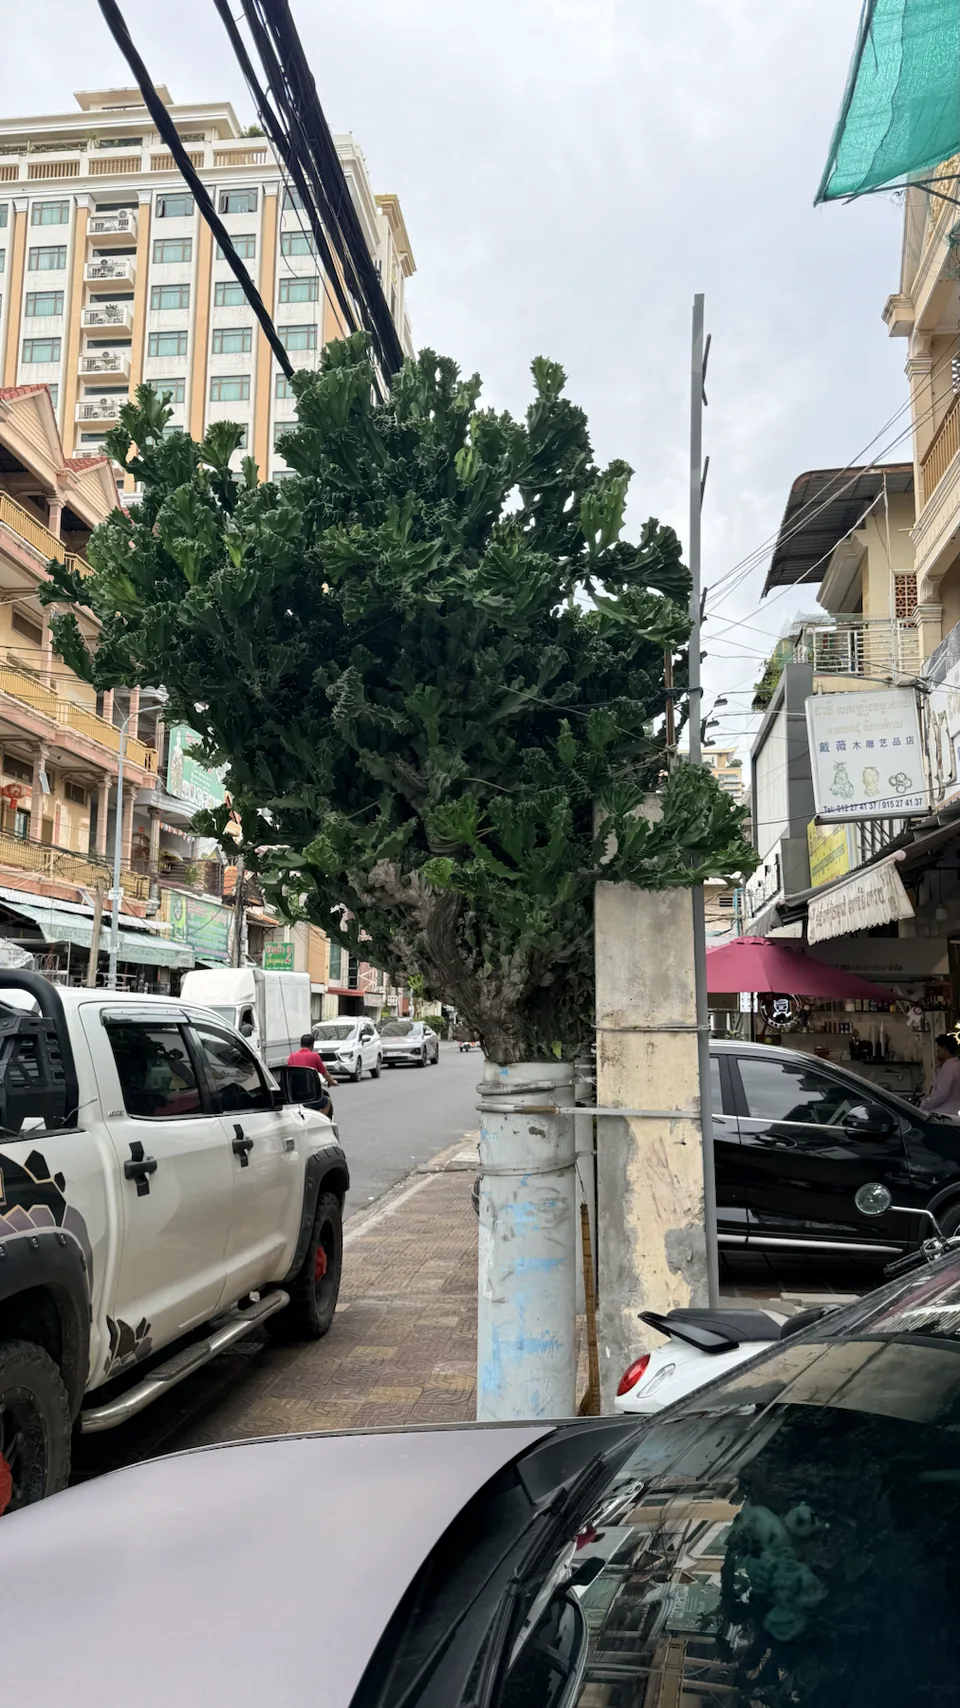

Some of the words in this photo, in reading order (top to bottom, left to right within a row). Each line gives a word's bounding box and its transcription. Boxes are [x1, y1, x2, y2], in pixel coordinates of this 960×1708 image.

[869, 802, 876, 810] 37
[882, 800, 894, 808] 015
[895, 799, 903, 807] 27
[915, 797, 922, 806] 37
